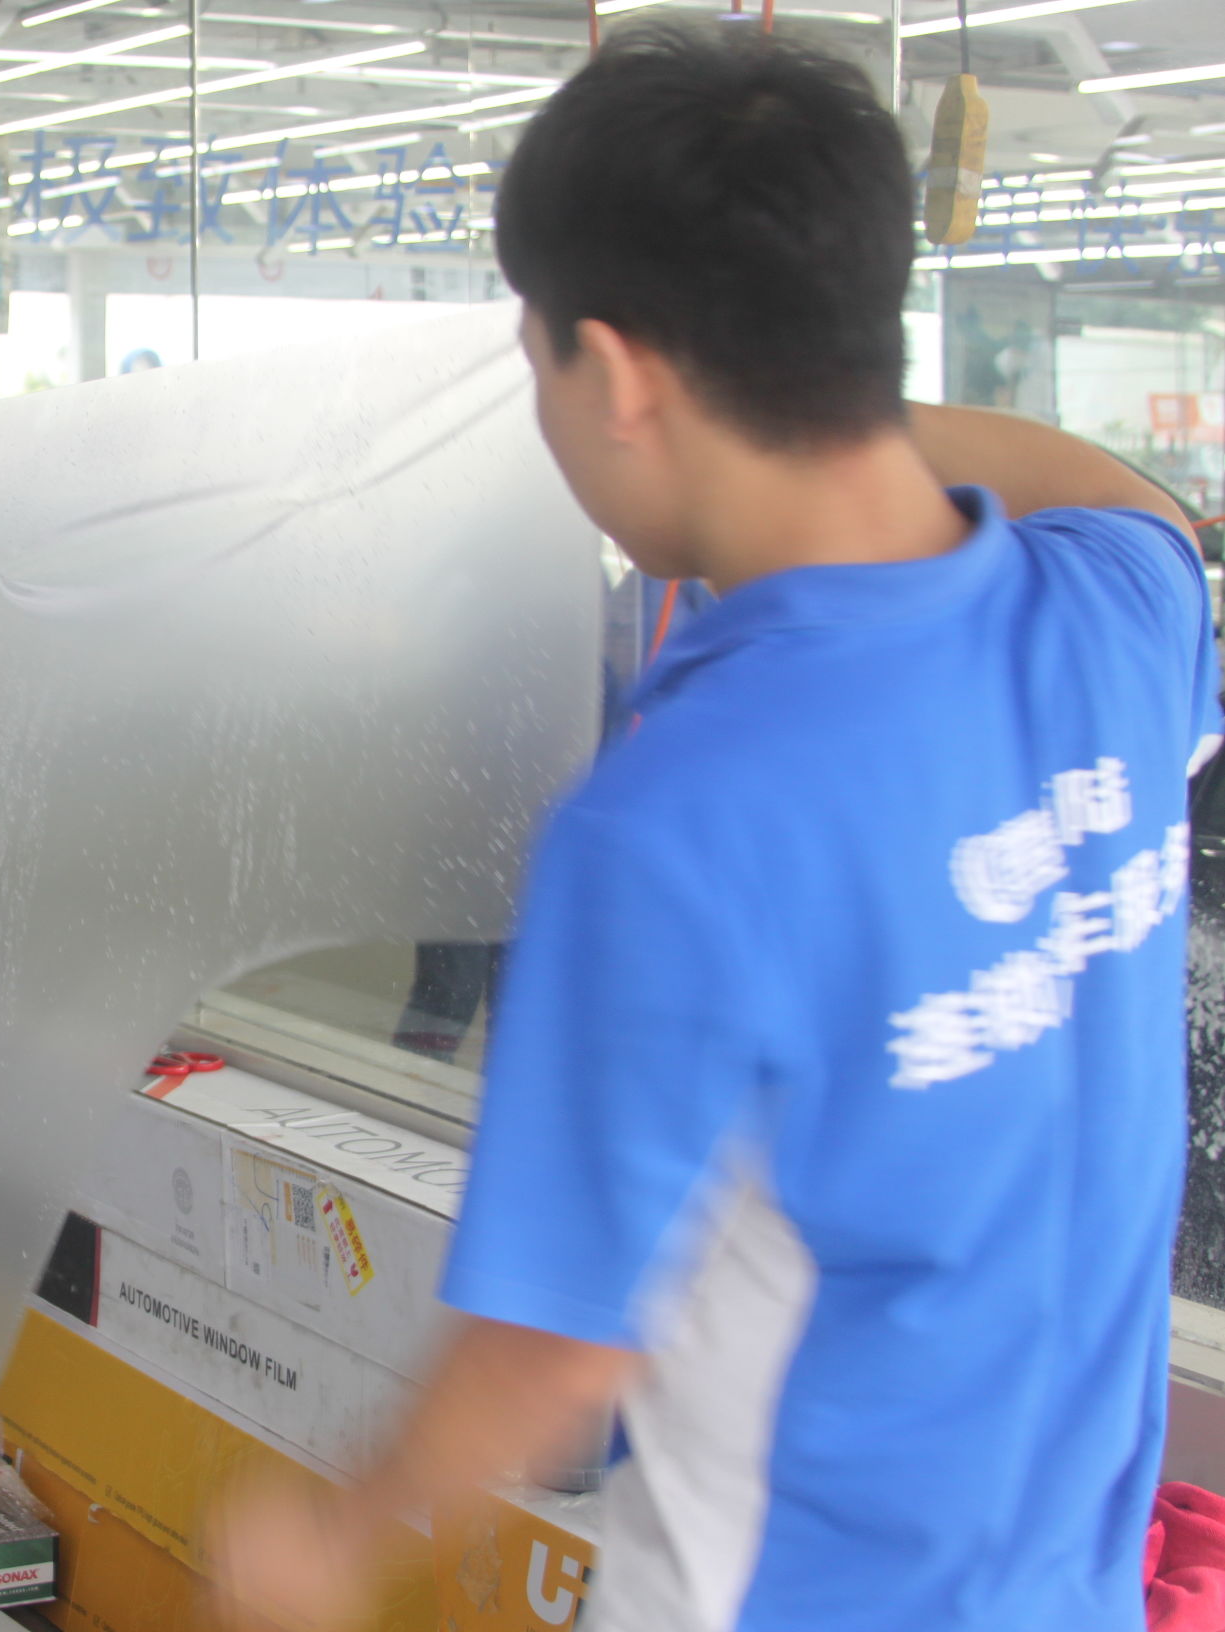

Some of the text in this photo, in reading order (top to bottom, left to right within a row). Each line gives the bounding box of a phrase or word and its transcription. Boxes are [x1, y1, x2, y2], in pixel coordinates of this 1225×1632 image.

[12, 126, 506, 257] 极致体验
[240, 1107, 470, 1195] AUTOMO
[119, 1281, 297, 1391] AUTOMOTIVE WINDOW FILM
